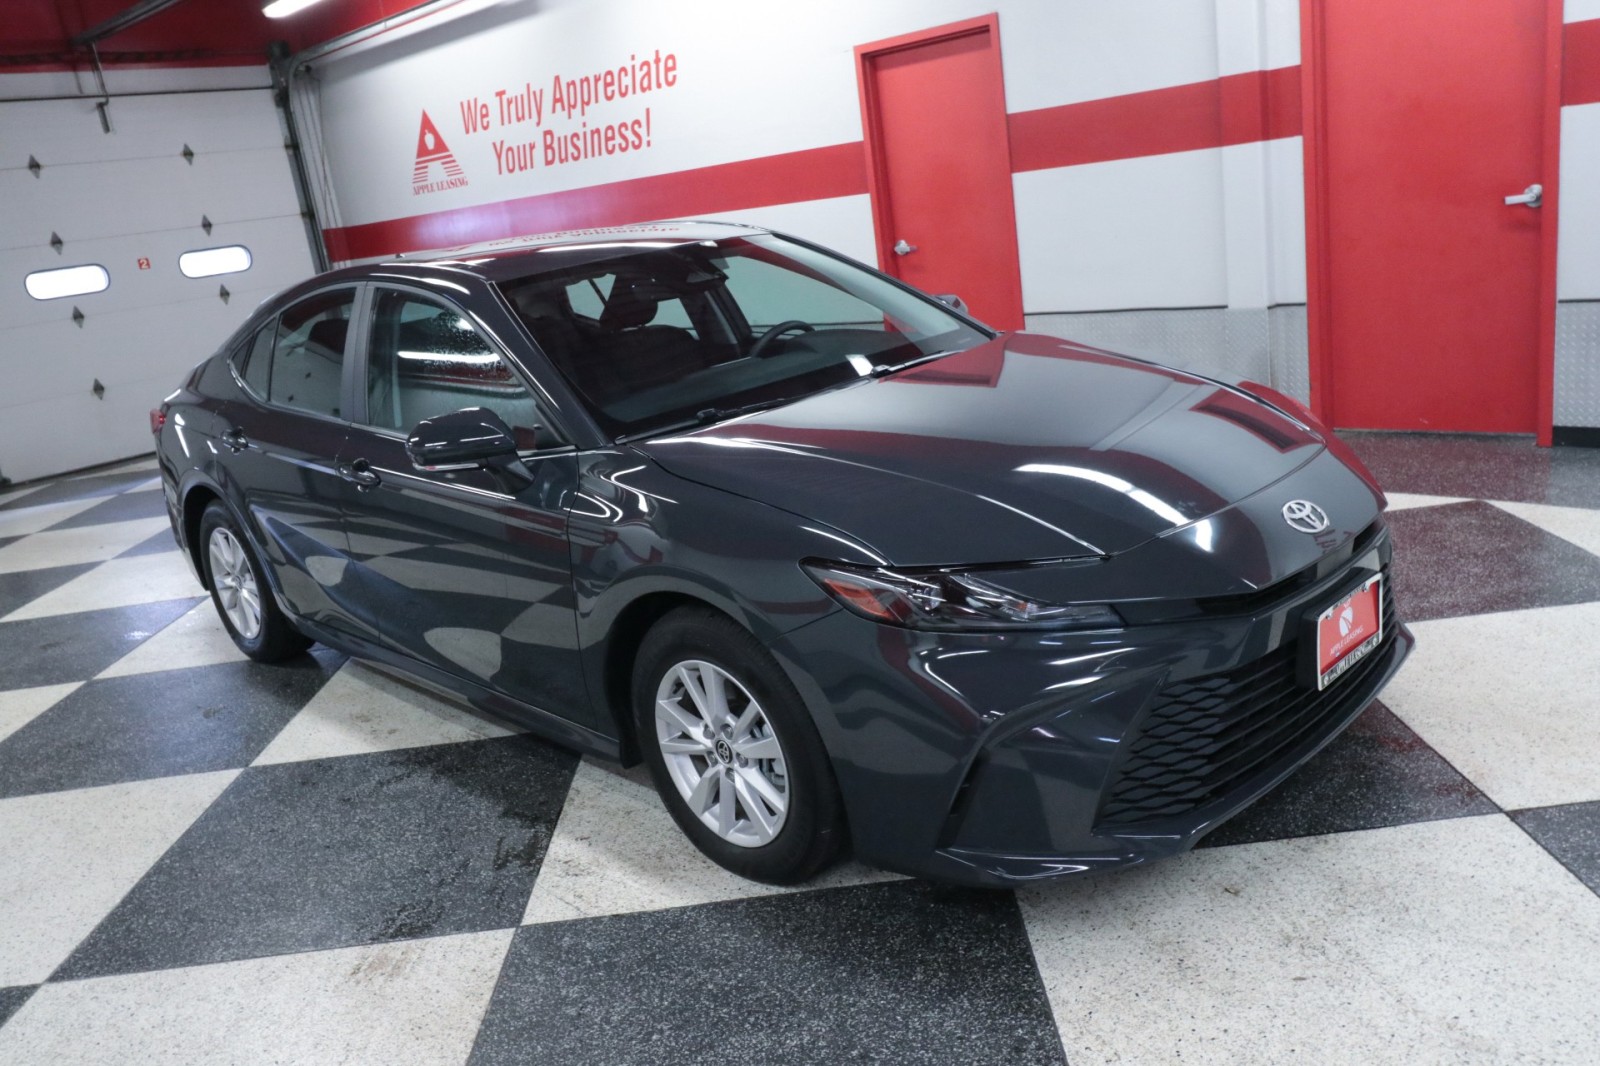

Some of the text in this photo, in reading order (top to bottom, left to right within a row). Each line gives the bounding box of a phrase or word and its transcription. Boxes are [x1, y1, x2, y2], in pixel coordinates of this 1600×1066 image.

[460, 49, 677, 135] We Truly Appreciate
[492, 107, 651, 176] Your Business!
[413, 176, 469, 196] APPLE LEASING
